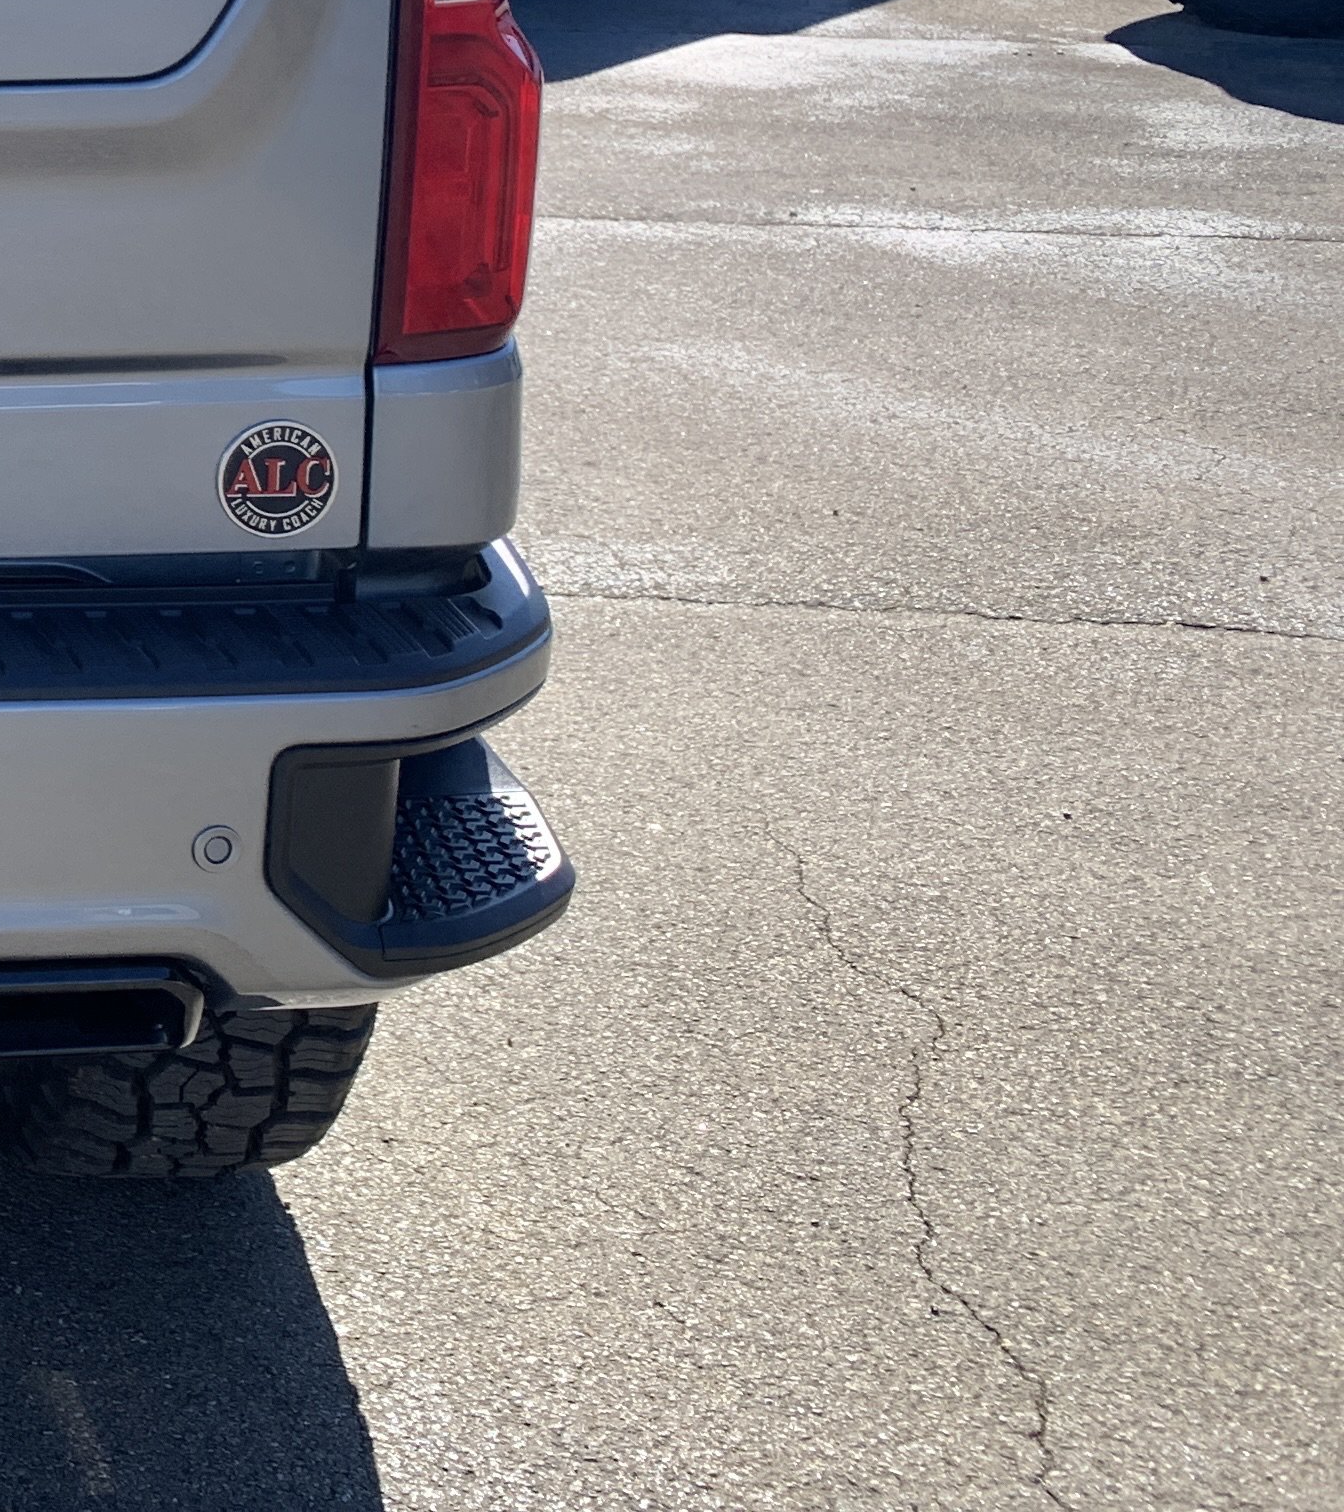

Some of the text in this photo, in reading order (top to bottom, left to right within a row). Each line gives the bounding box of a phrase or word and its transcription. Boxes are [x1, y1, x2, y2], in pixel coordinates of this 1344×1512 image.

[240, 427, 322, 456] AMERICAN
[226, 457, 330, 498] ALC
[230, 498, 324, 532] LUXURY COACH
